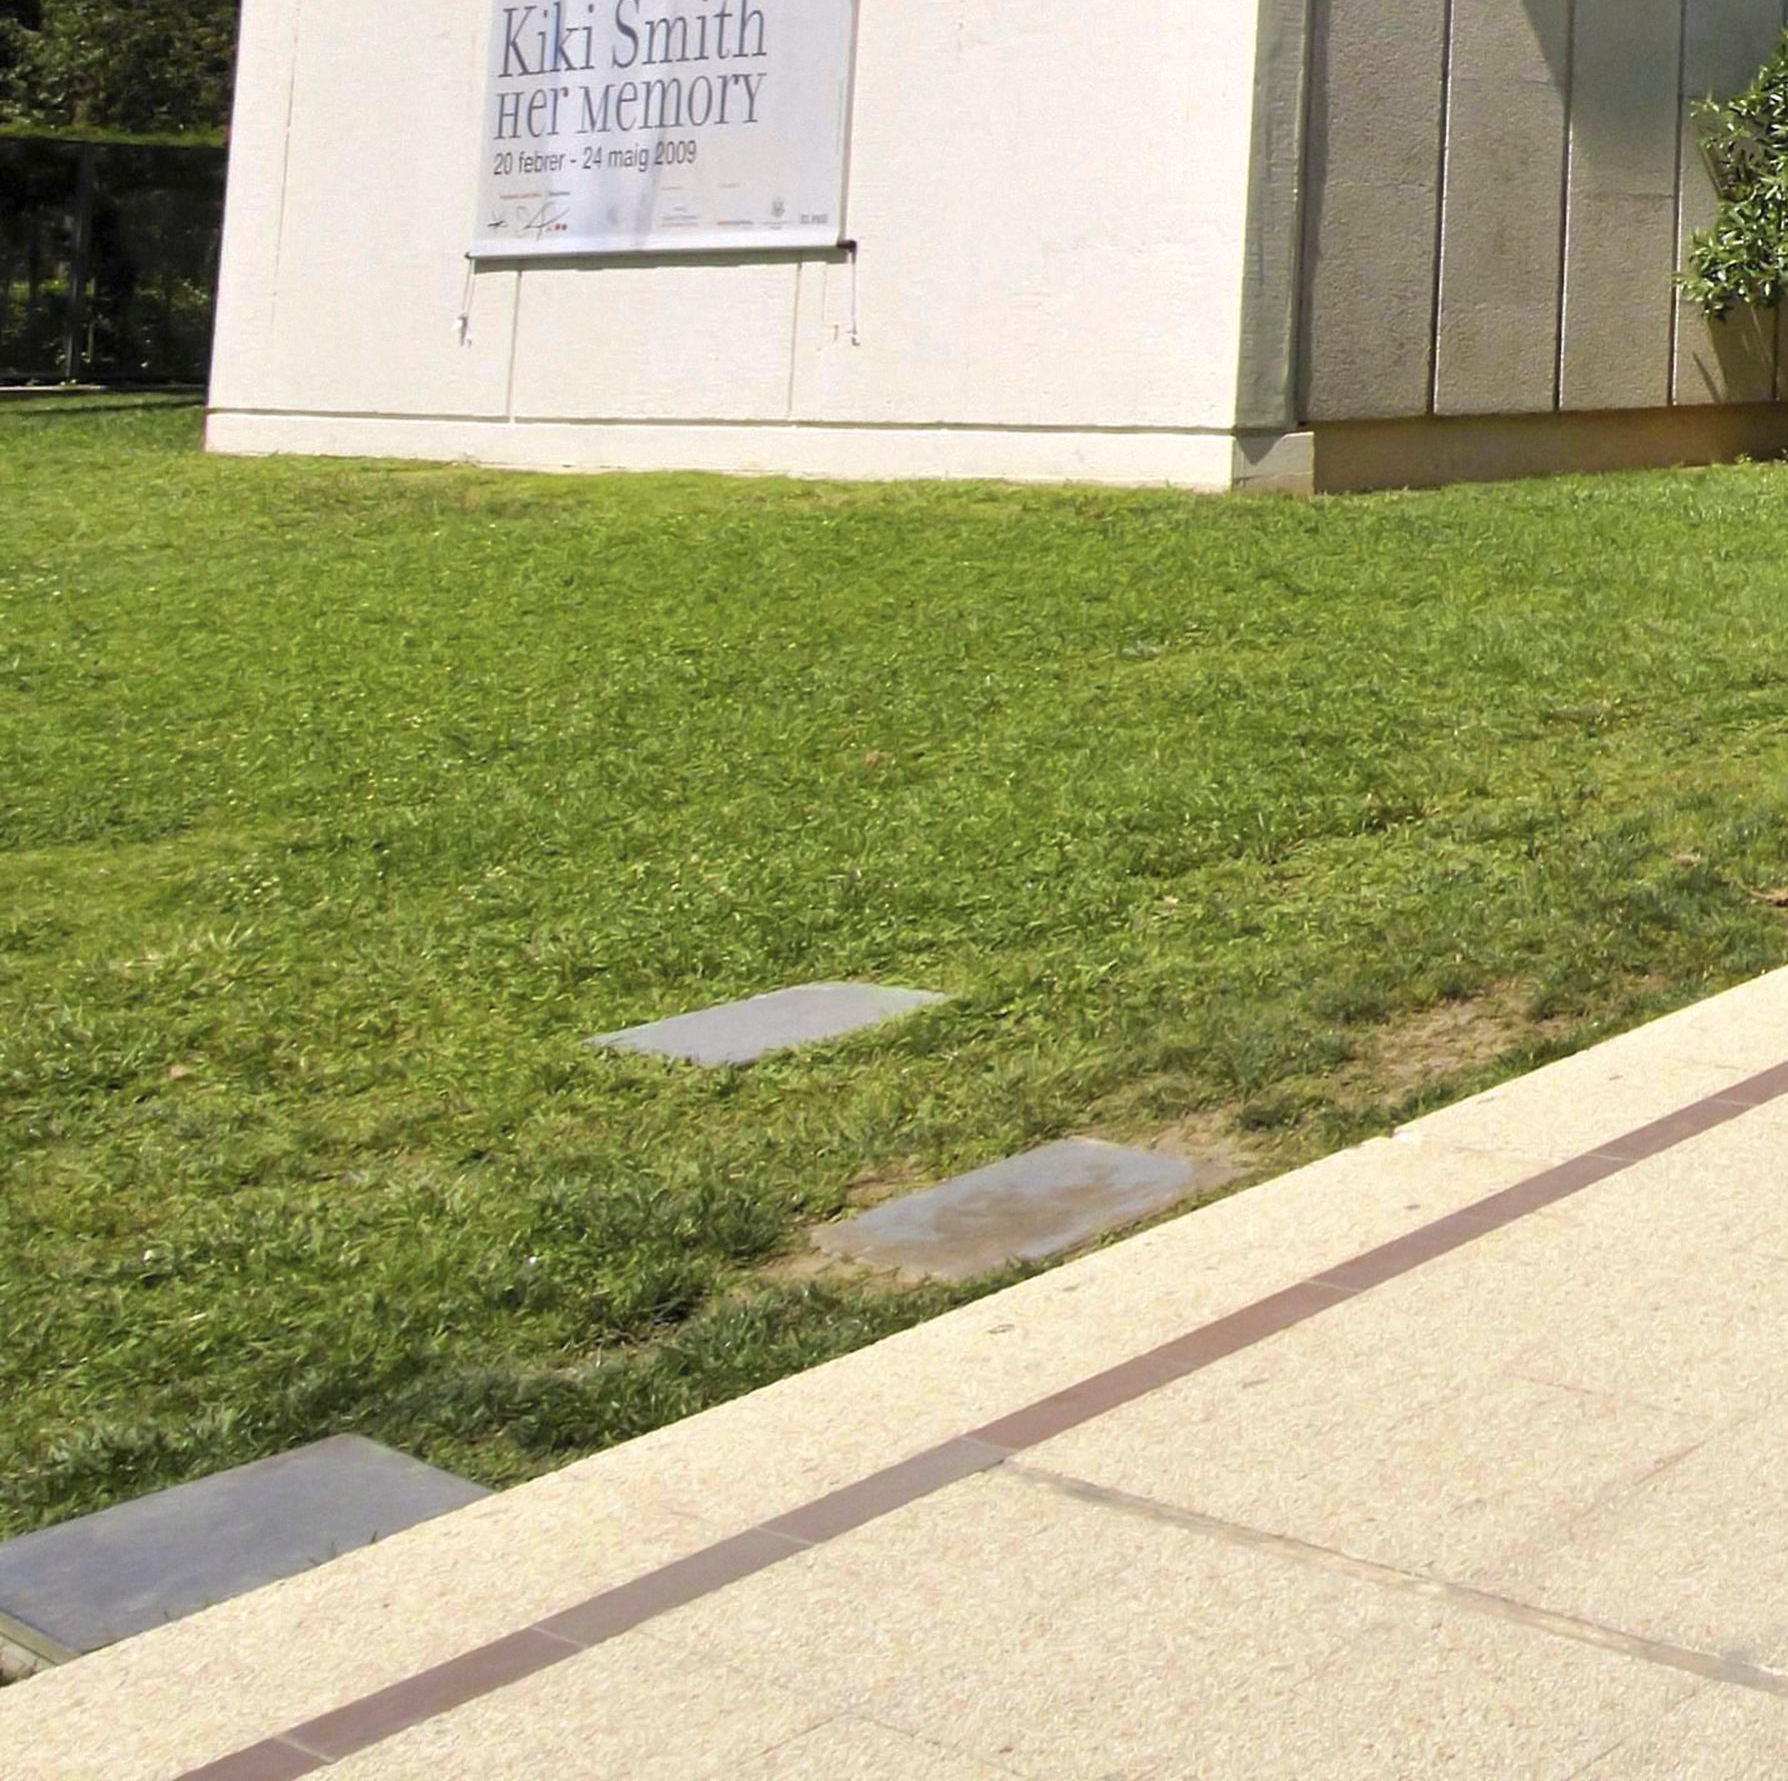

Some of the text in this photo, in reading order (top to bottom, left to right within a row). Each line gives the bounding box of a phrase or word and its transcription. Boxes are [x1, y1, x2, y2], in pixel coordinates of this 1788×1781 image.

[498, 2, 595, 78] Kiki
[493, 152, 513, 175] 20
[518, 149, 565, 172] febrer
[583, 146, 603, 170] 24
[608, 144, 649, 172] maig
[654, 140, 697, 165] 2009
